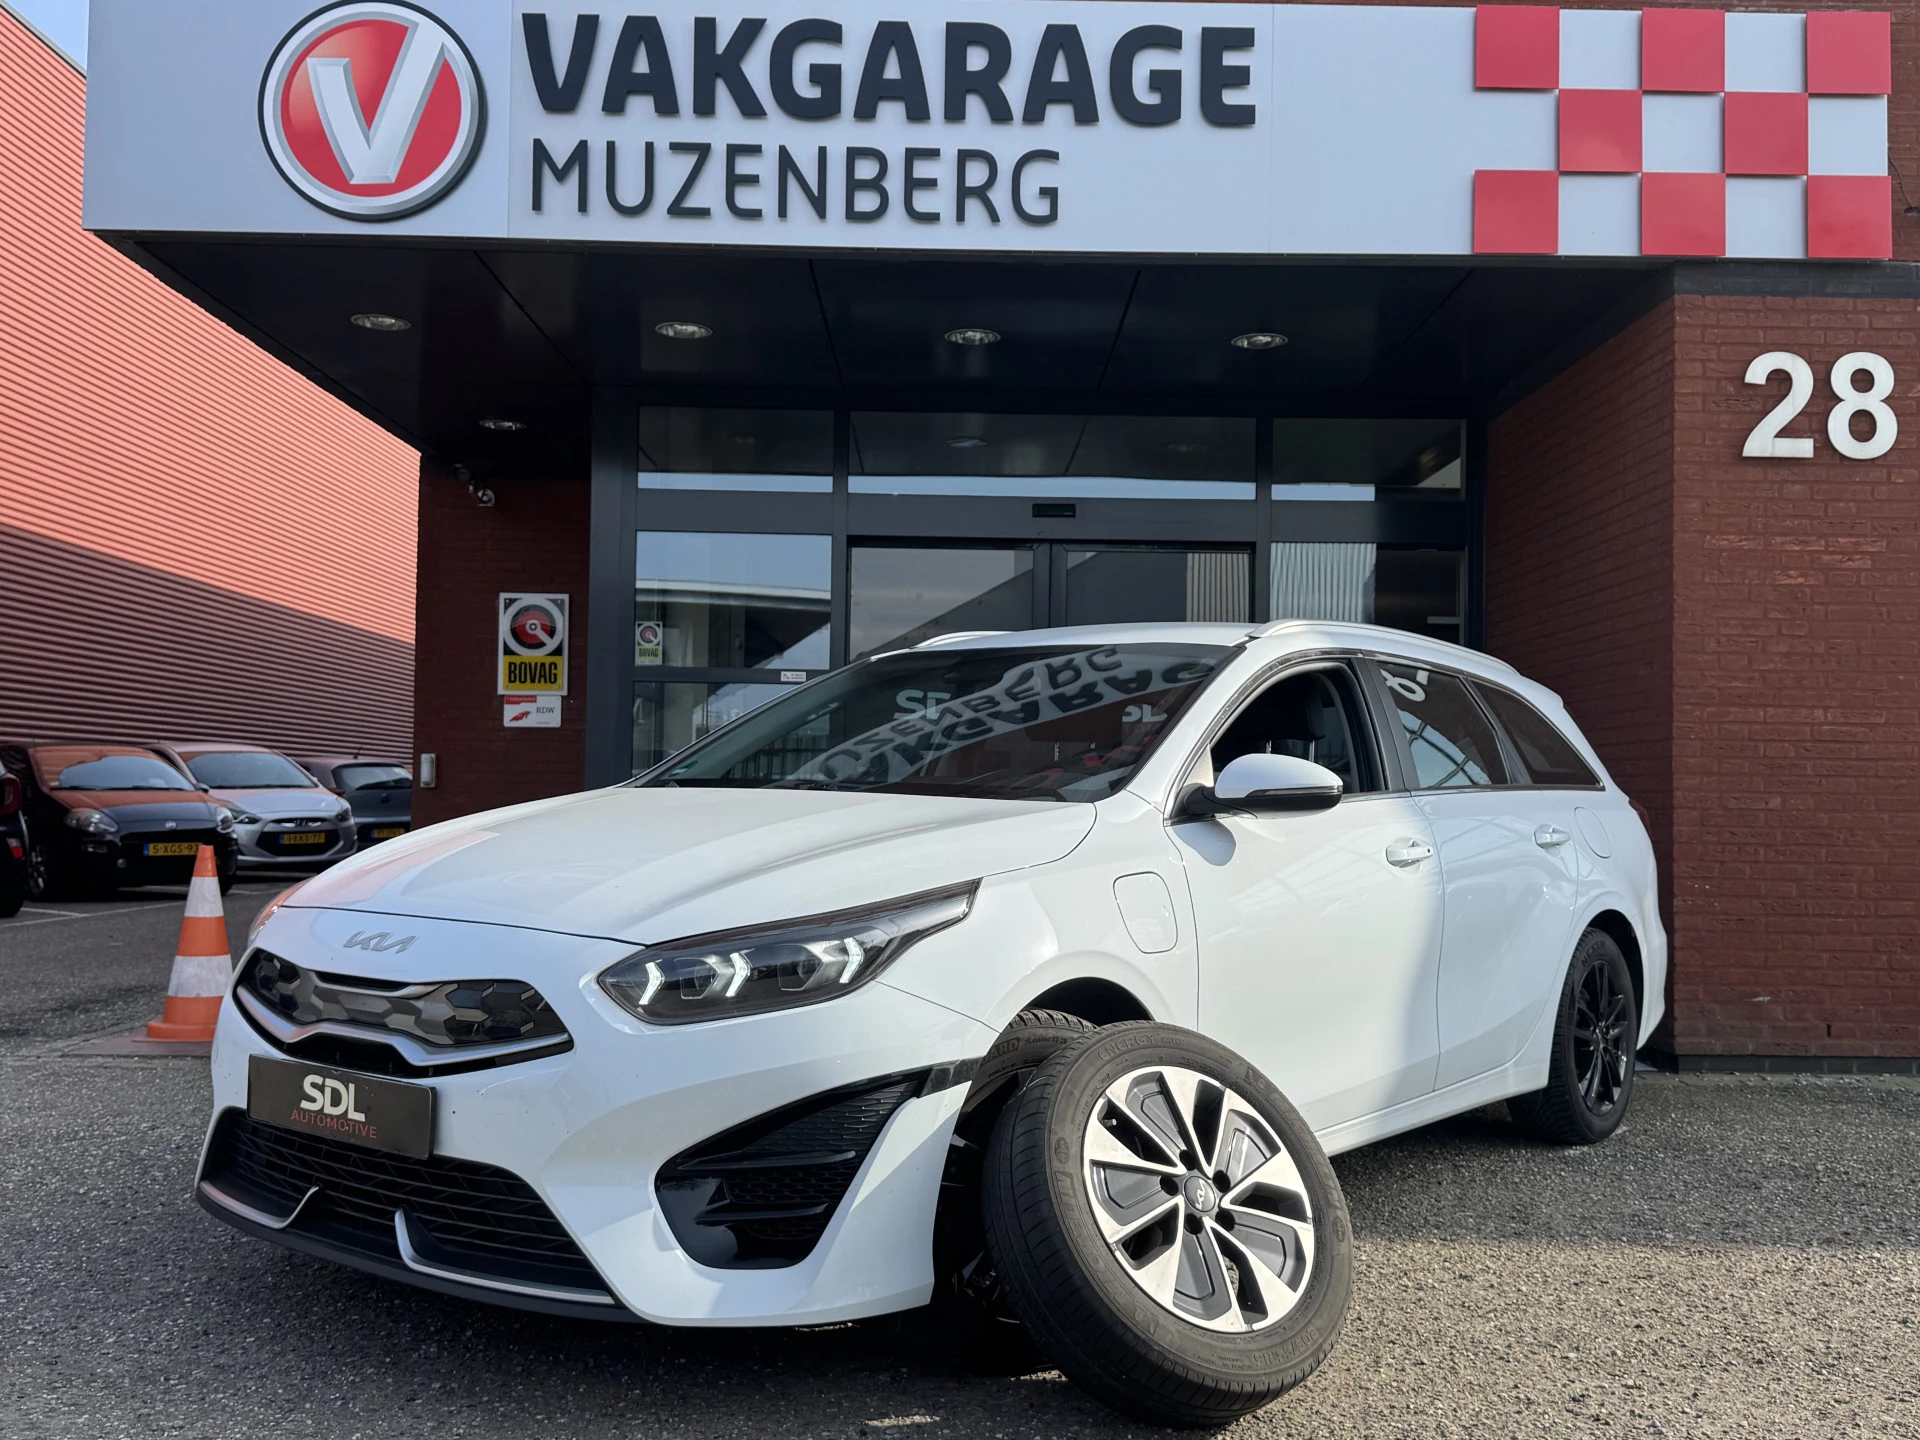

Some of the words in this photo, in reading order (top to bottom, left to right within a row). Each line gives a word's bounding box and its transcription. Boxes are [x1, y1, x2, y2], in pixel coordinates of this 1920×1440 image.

[522, 13, 1256, 126] VAKGARAGE
[306, 20, 446, 184] V
[530, 137, 1060, 225] MUZENBERG
[1741, 351, 1899, 460] 28
[638, 647, 659, 657] BOVAG
[508, 661, 558, 685] BOVAG
[536, 706, 556, 714] RDW
[344, 930, 419, 954] KIA
[299, 1074, 365, 1122] SDL
[290, 1108, 378, 1139] AUTOMOTIVE
